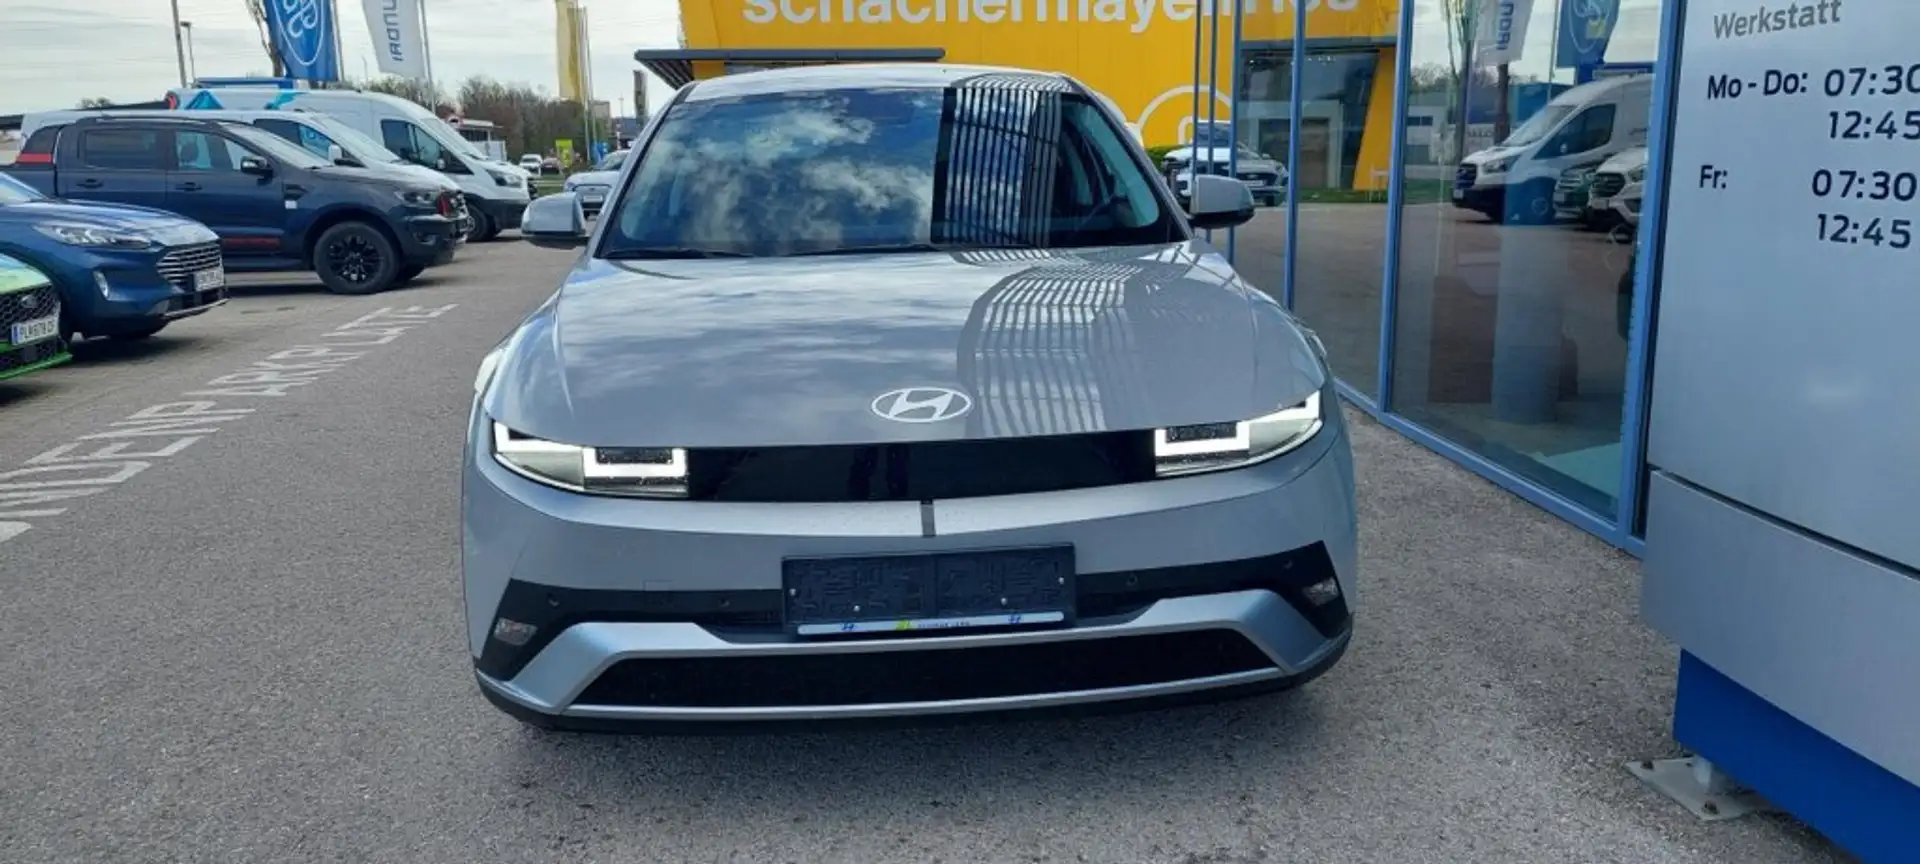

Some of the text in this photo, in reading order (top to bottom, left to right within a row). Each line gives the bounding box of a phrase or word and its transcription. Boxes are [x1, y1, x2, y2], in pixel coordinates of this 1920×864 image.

[1714, 0, 1843, 39] Werkstatt
[1707, 74, 1742, 100] Mo
[1763, 69, 1808, 96] Do:
[1824, 63, 1920, 97] 07:30
[1829, 110, 1920, 140] 12:45
[1700, 164, 1918, 201] Fr: 07:30
[1817, 213, 1911, 249] 12:45
